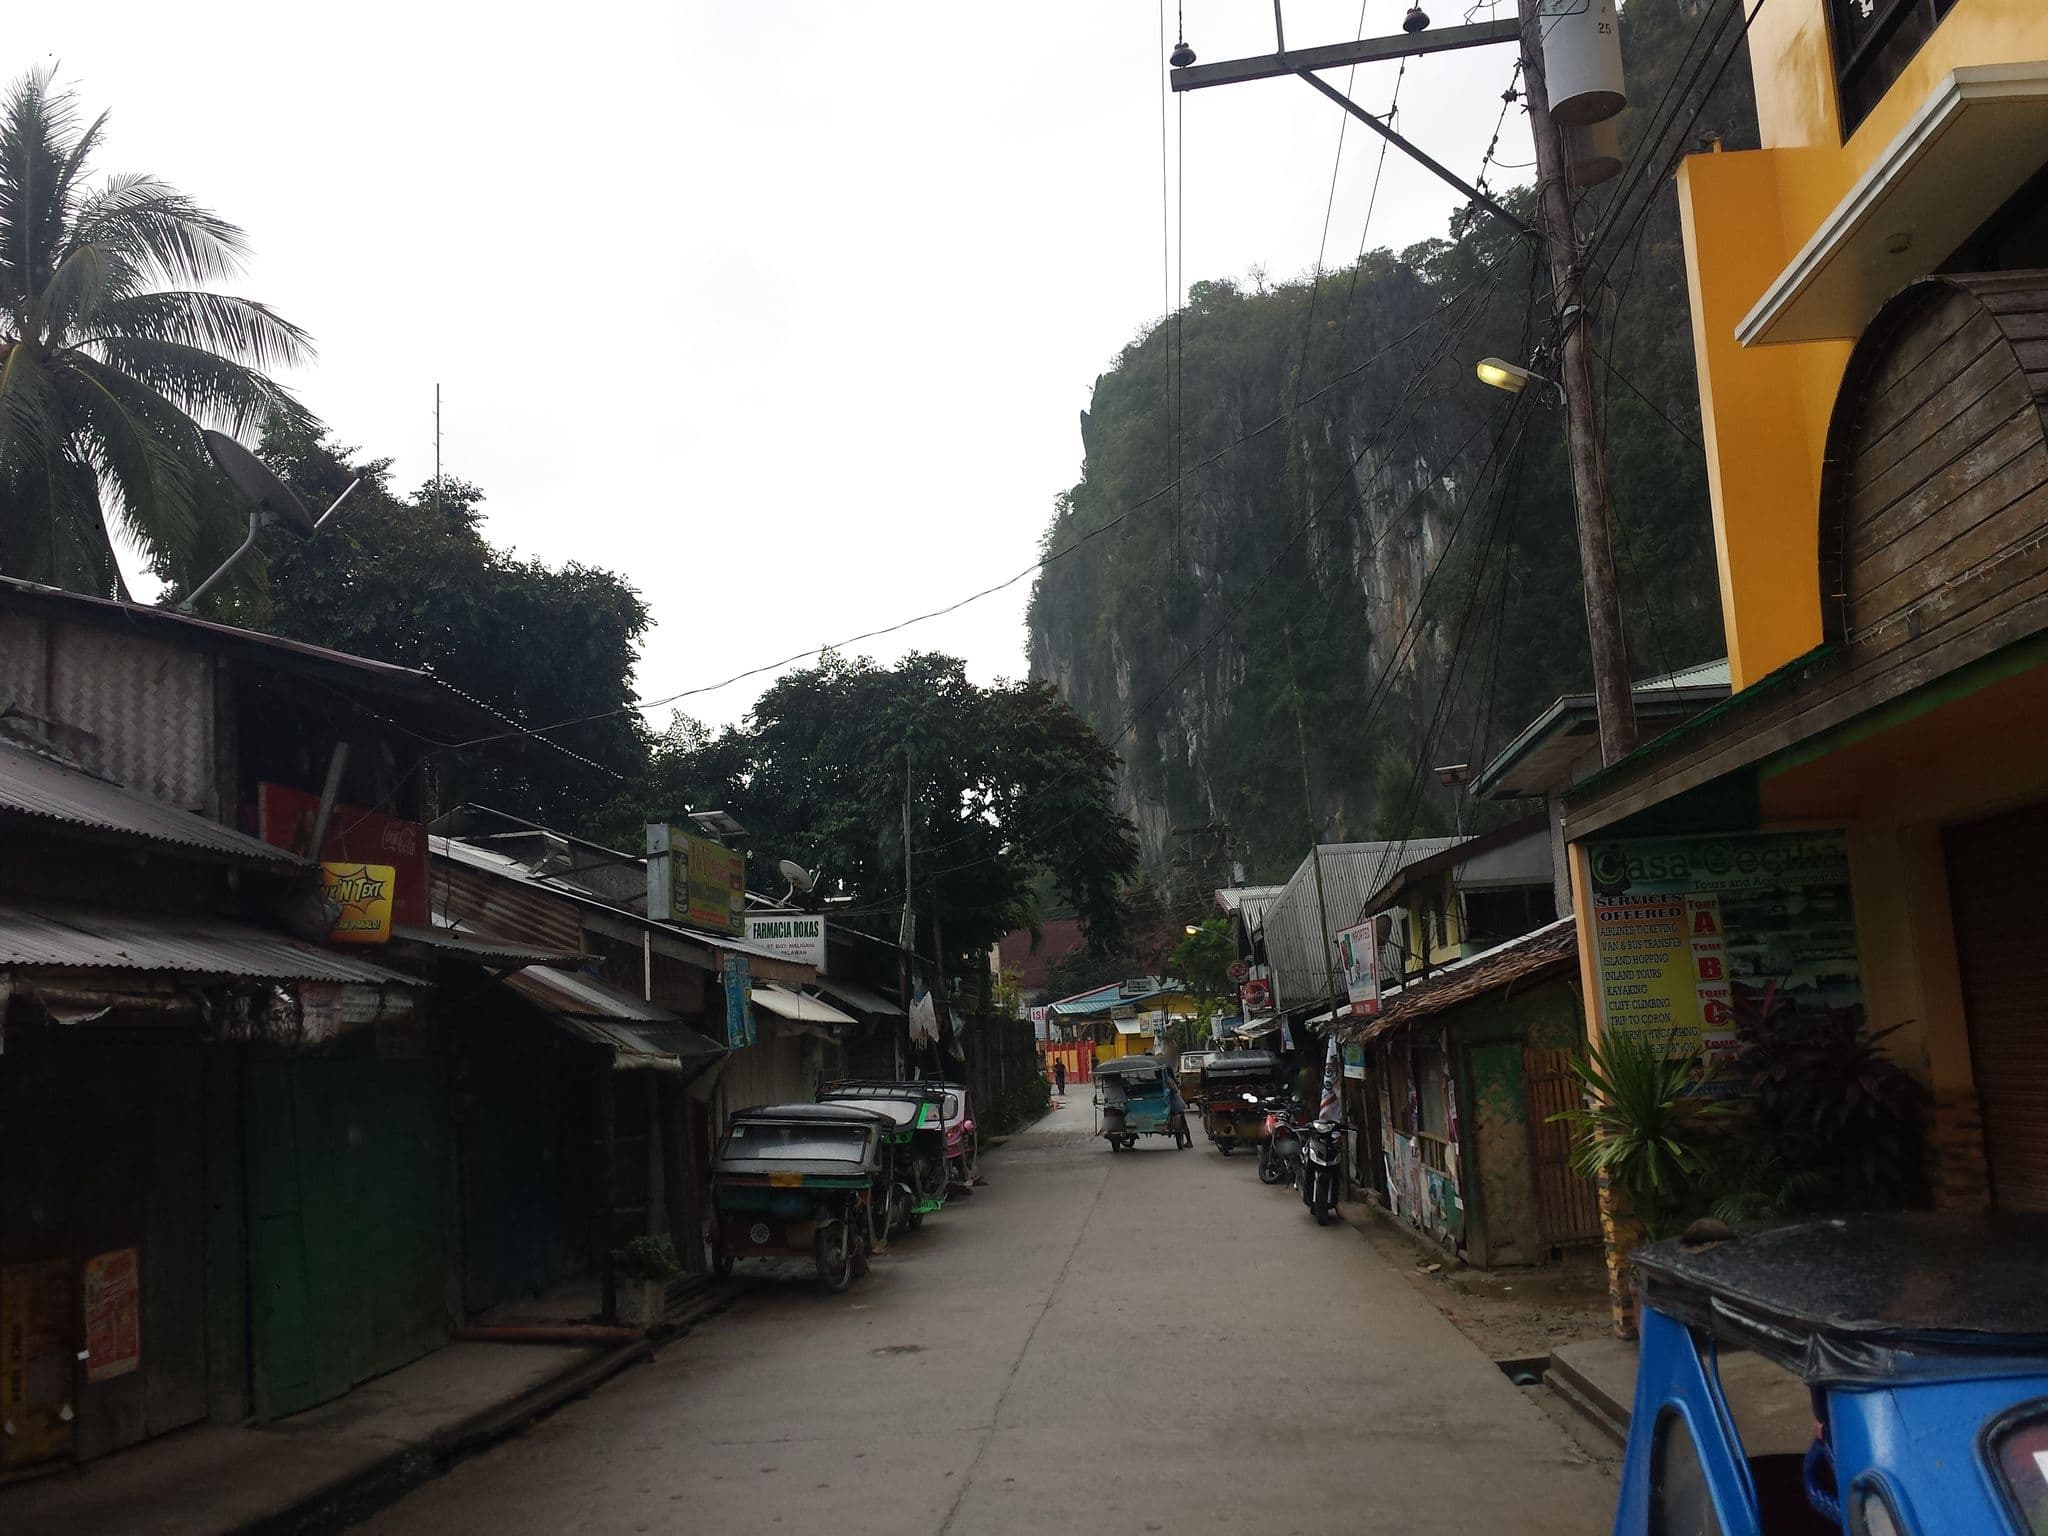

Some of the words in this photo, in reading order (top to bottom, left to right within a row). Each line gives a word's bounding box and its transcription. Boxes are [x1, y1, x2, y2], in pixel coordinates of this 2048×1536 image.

[1598, 22, 1611, 35] 25
[1591, 845, 1692, 885] Casa
[1695, 880, 1725, 890] Tours
[1728, 879, 1750, 888] and
[1596, 893, 1682, 907] SERVICES
[1688, 900, 1715, 910] Tour
[1600, 908, 1681, 921] OFFERED
[1694, 911, 1716, 934] A
[753, 921, 791, 939] FARMACIA
[793, 921, 819, 938] ROXAS
[1601, 926, 1634, 936] AIRLINES
[1635, 923, 1678, 935] TICKETING
[1601, 941, 1619, 951] VAN
[1628, 940, 1642, 949] BUS
[1692, 943, 1722, 953] Tour
[1603, 955, 1631, 966] ISLAND
[1633, 953, 1669, 964] HOPPING
[1605, 970, 1634, 981] INLAND
[1636, 969, 1662, 979] TOURS
[1698, 957, 1723, 981] B
[1607, 984, 1648, 996] KAYAKING
[1698, 989, 1728, 999] Tour
[1608, 1000, 1630, 1011] CLIFF
[1632, 998, 1671, 1009] CLIMBING
[1703, 999, 1730, 1026] C
[1610, 1015, 1627, 1026] TRIP
[1628, 1015, 1640, 1025] TO
[1641, 1013, 1671, 1024] CORON
